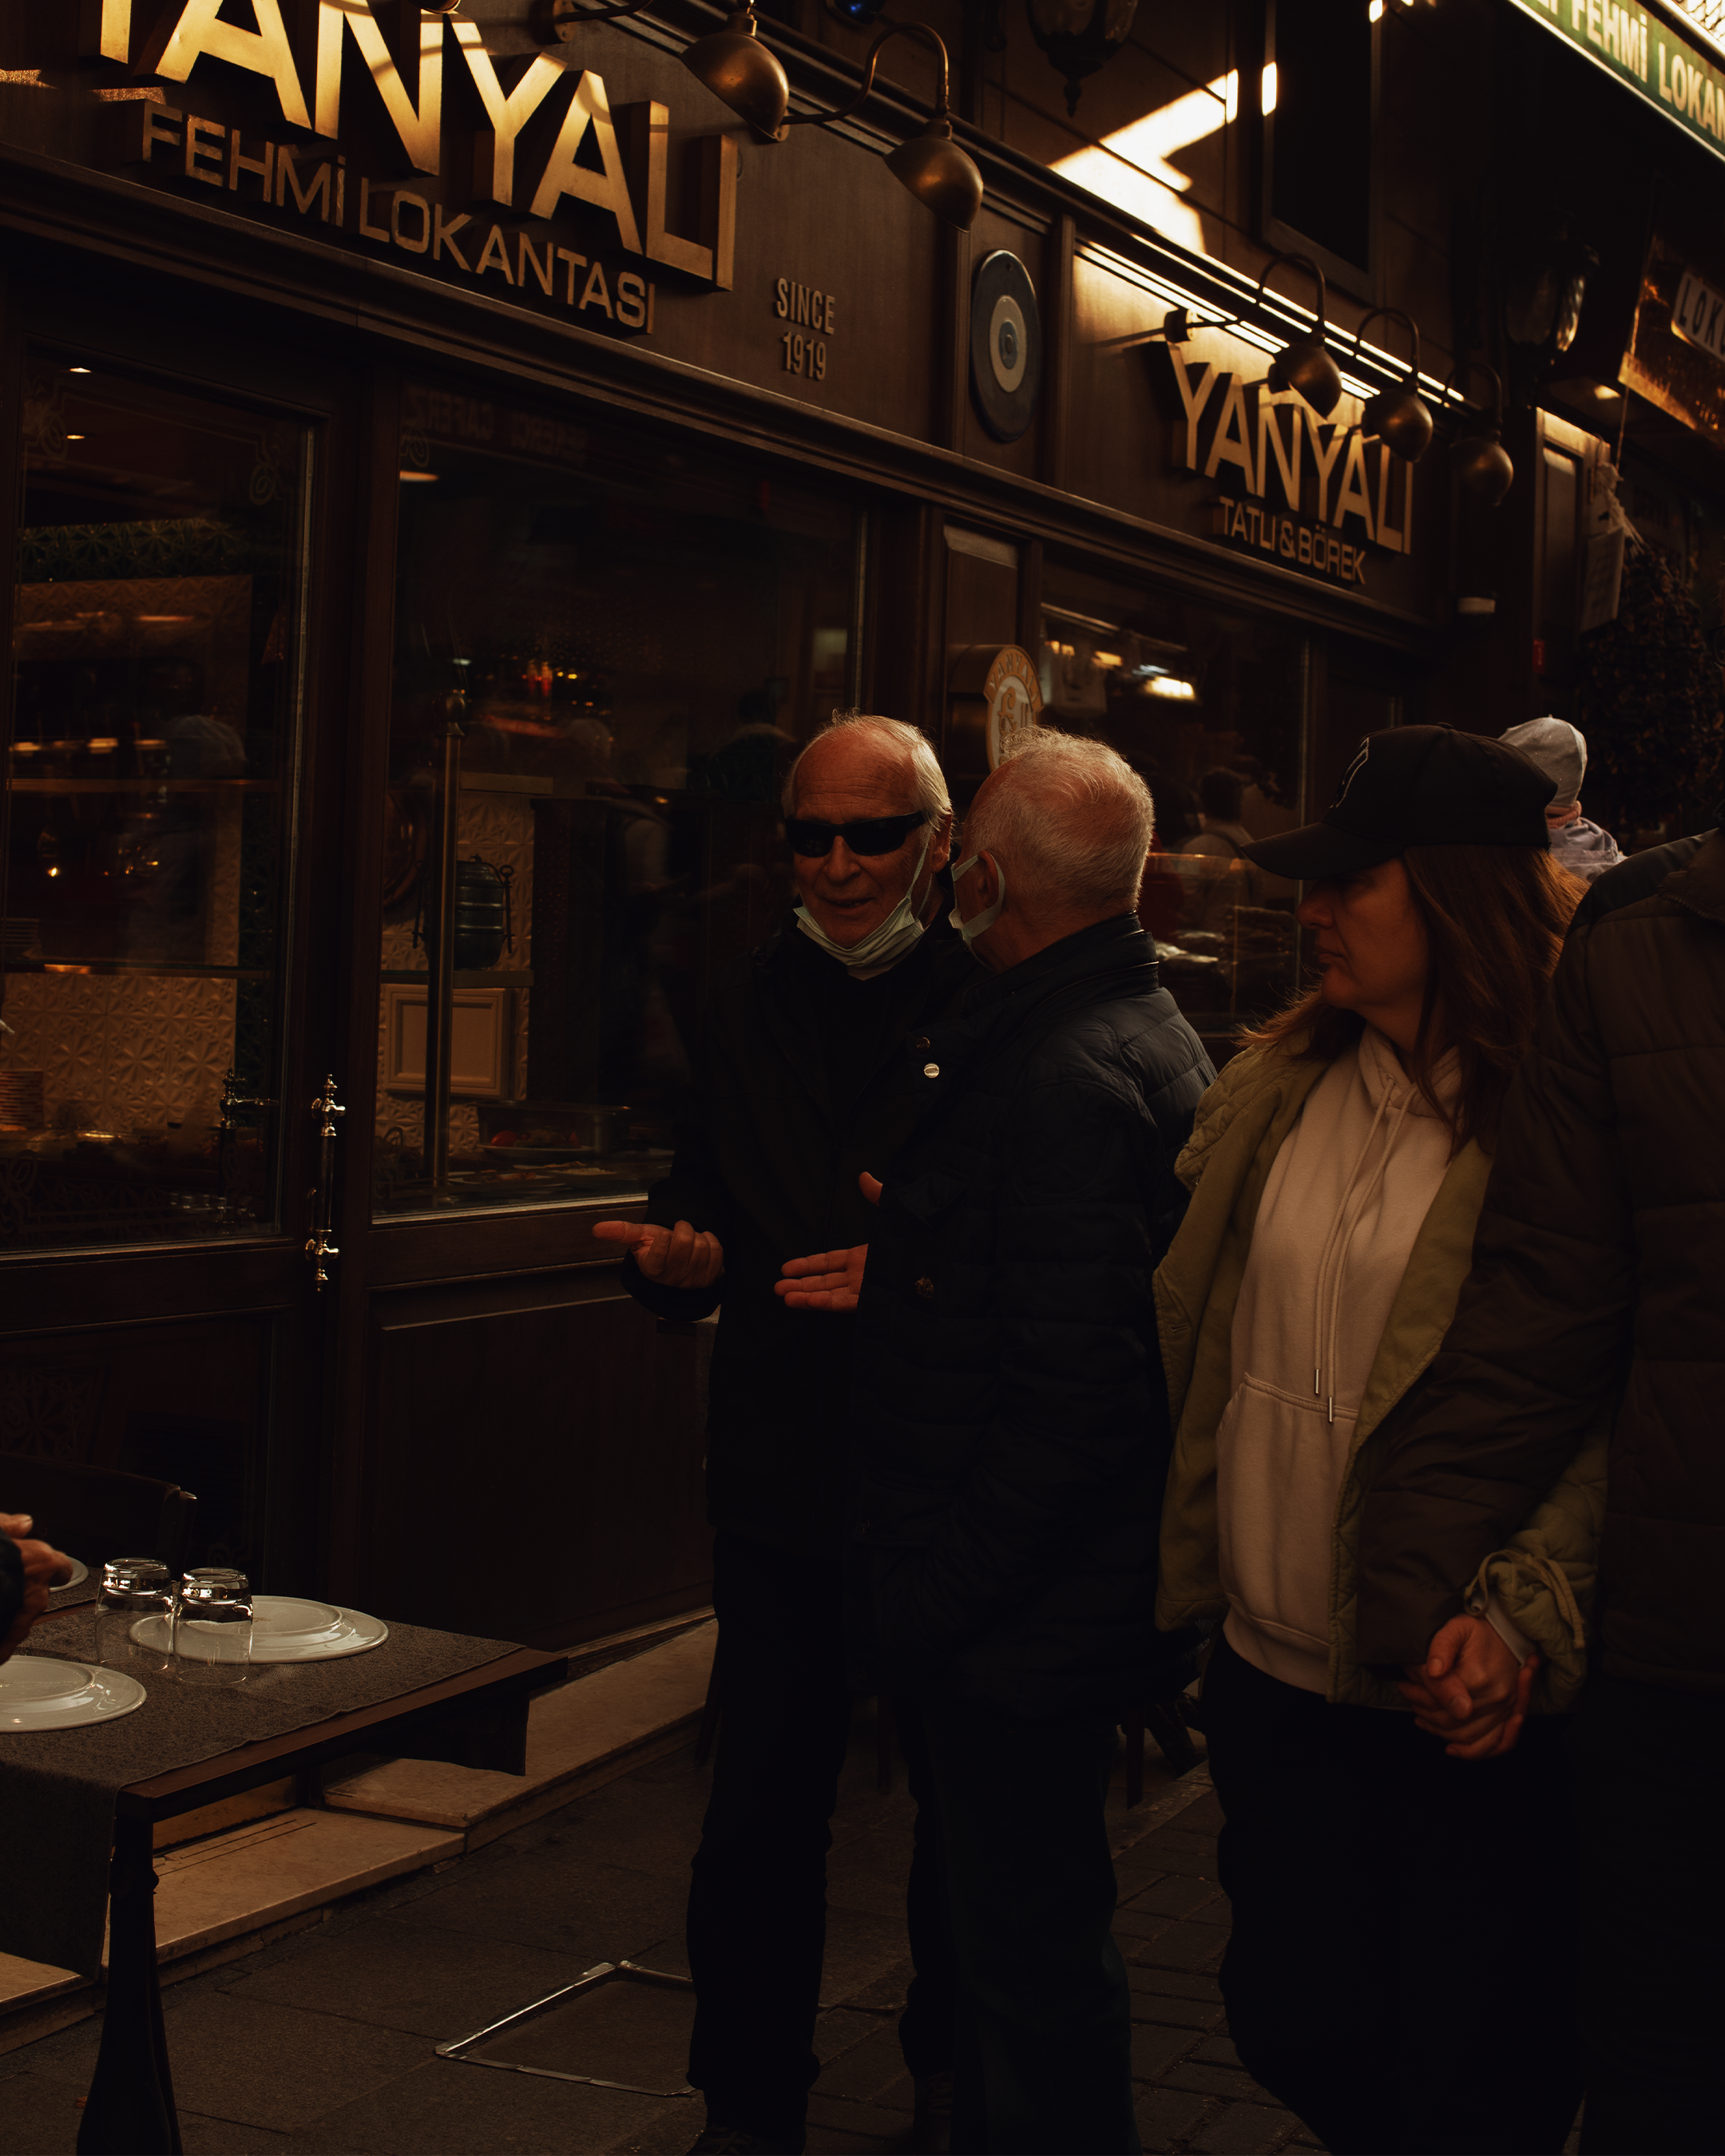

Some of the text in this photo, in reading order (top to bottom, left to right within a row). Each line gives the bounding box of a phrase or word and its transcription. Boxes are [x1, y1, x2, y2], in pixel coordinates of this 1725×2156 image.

[143, 99, 656, 334] FEHMİ LOKANTASI
[776, 277, 835, 335] SINCE
[783, 331, 827, 381] 1919
[1167, 342, 1413, 555] YANYALI
[1219, 495, 1276, 552] TATLI
[1298, 524, 1366, 585] BÖREK
[989, 652, 1039, 704] YANYALI
